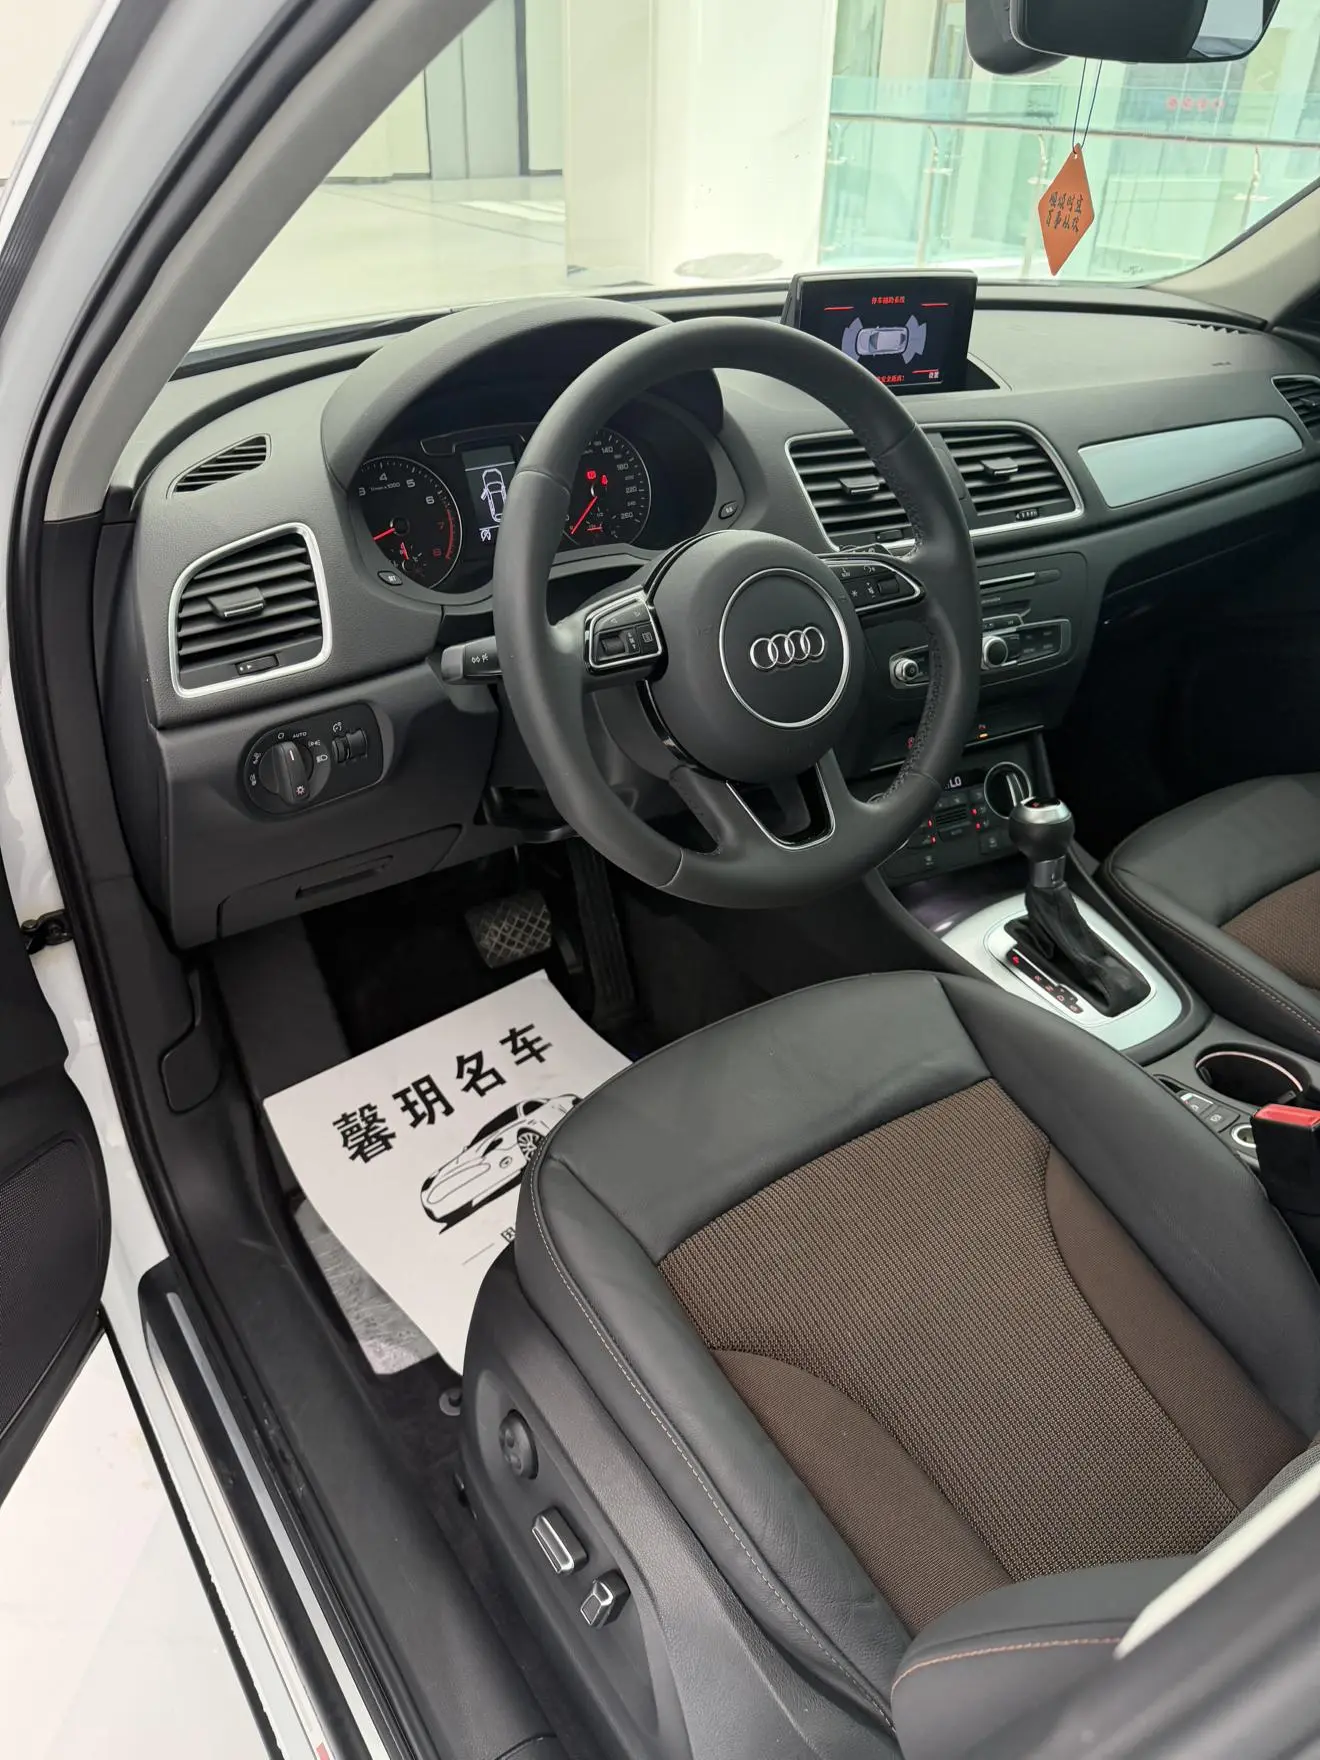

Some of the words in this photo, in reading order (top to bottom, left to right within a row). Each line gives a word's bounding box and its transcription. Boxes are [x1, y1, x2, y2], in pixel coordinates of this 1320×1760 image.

[379, 473, 388, 481] 4
[406, 479, 415, 488] 5
[358, 487, 366, 496] 3
[425, 496, 435, 505] 6
[332, 1023, 554, 1164] 馨玥名车
